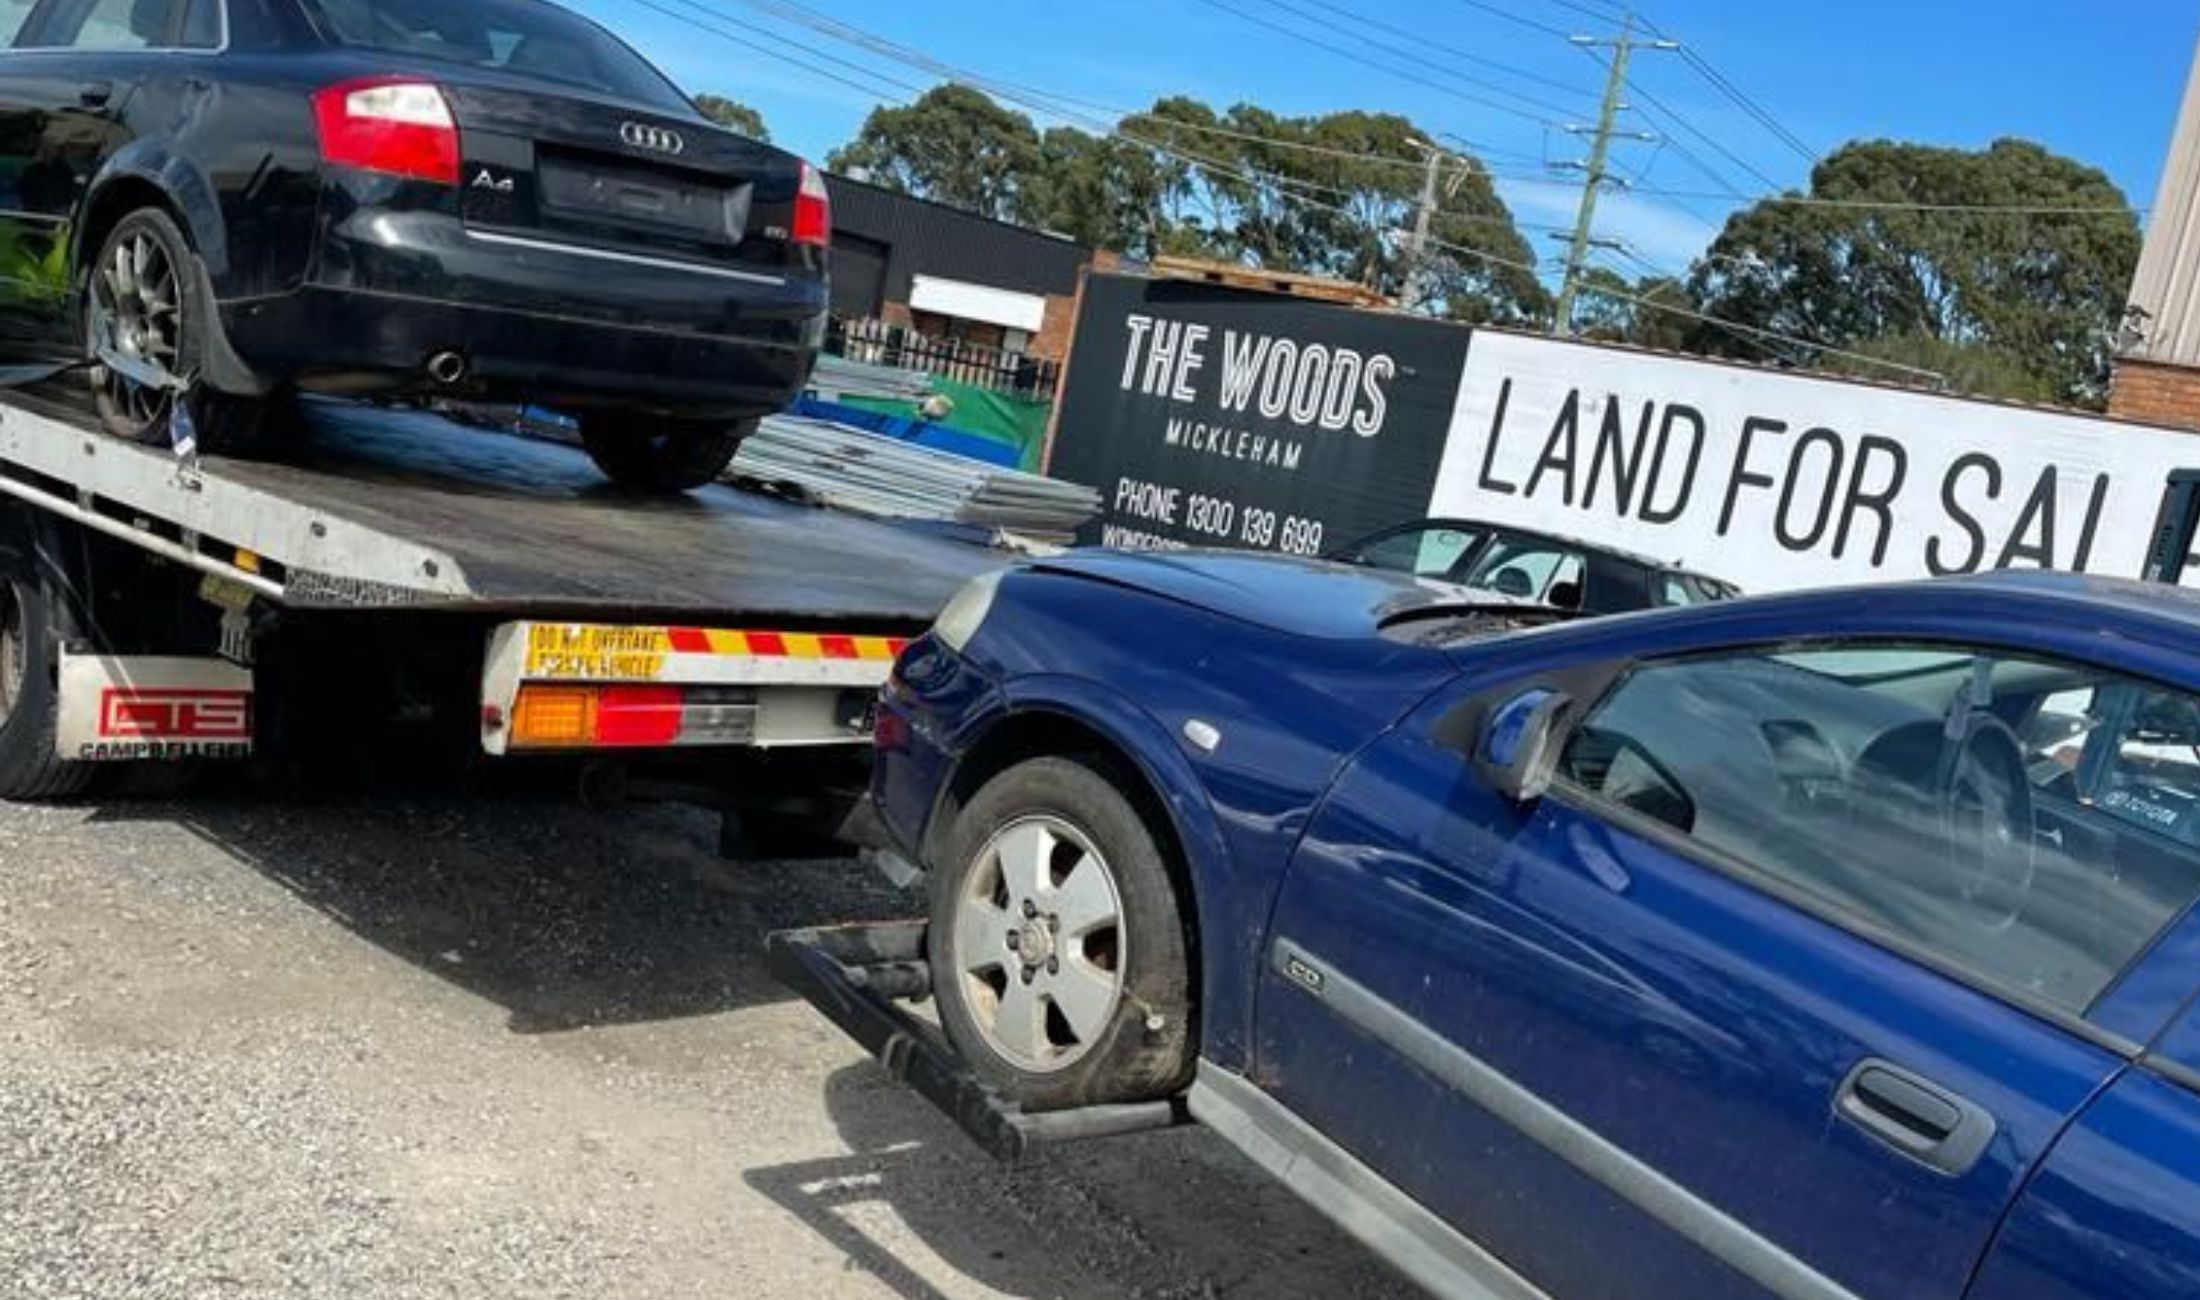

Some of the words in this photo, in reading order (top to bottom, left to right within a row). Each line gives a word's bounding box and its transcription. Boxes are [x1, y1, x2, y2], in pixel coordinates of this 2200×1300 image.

[471, 168, 515, 192] A4
[1120, 313, 1211, 403] THE
[1219, 329, 1395, 437] WOODS
[1164, 416, 1303, 470] MICKLEHAM
[1478, 377, 1706, 524] LAND
[1715, 415, 1908, 568] FOR
[1924, 451, 2200, 578] SAL
[1115, 476, 1182, 525] PHONE
[1186, 492, 1235, 537] 1300
[1241, 506, 1276, 549] 139
[1280, 515, 1323, 555] 699
